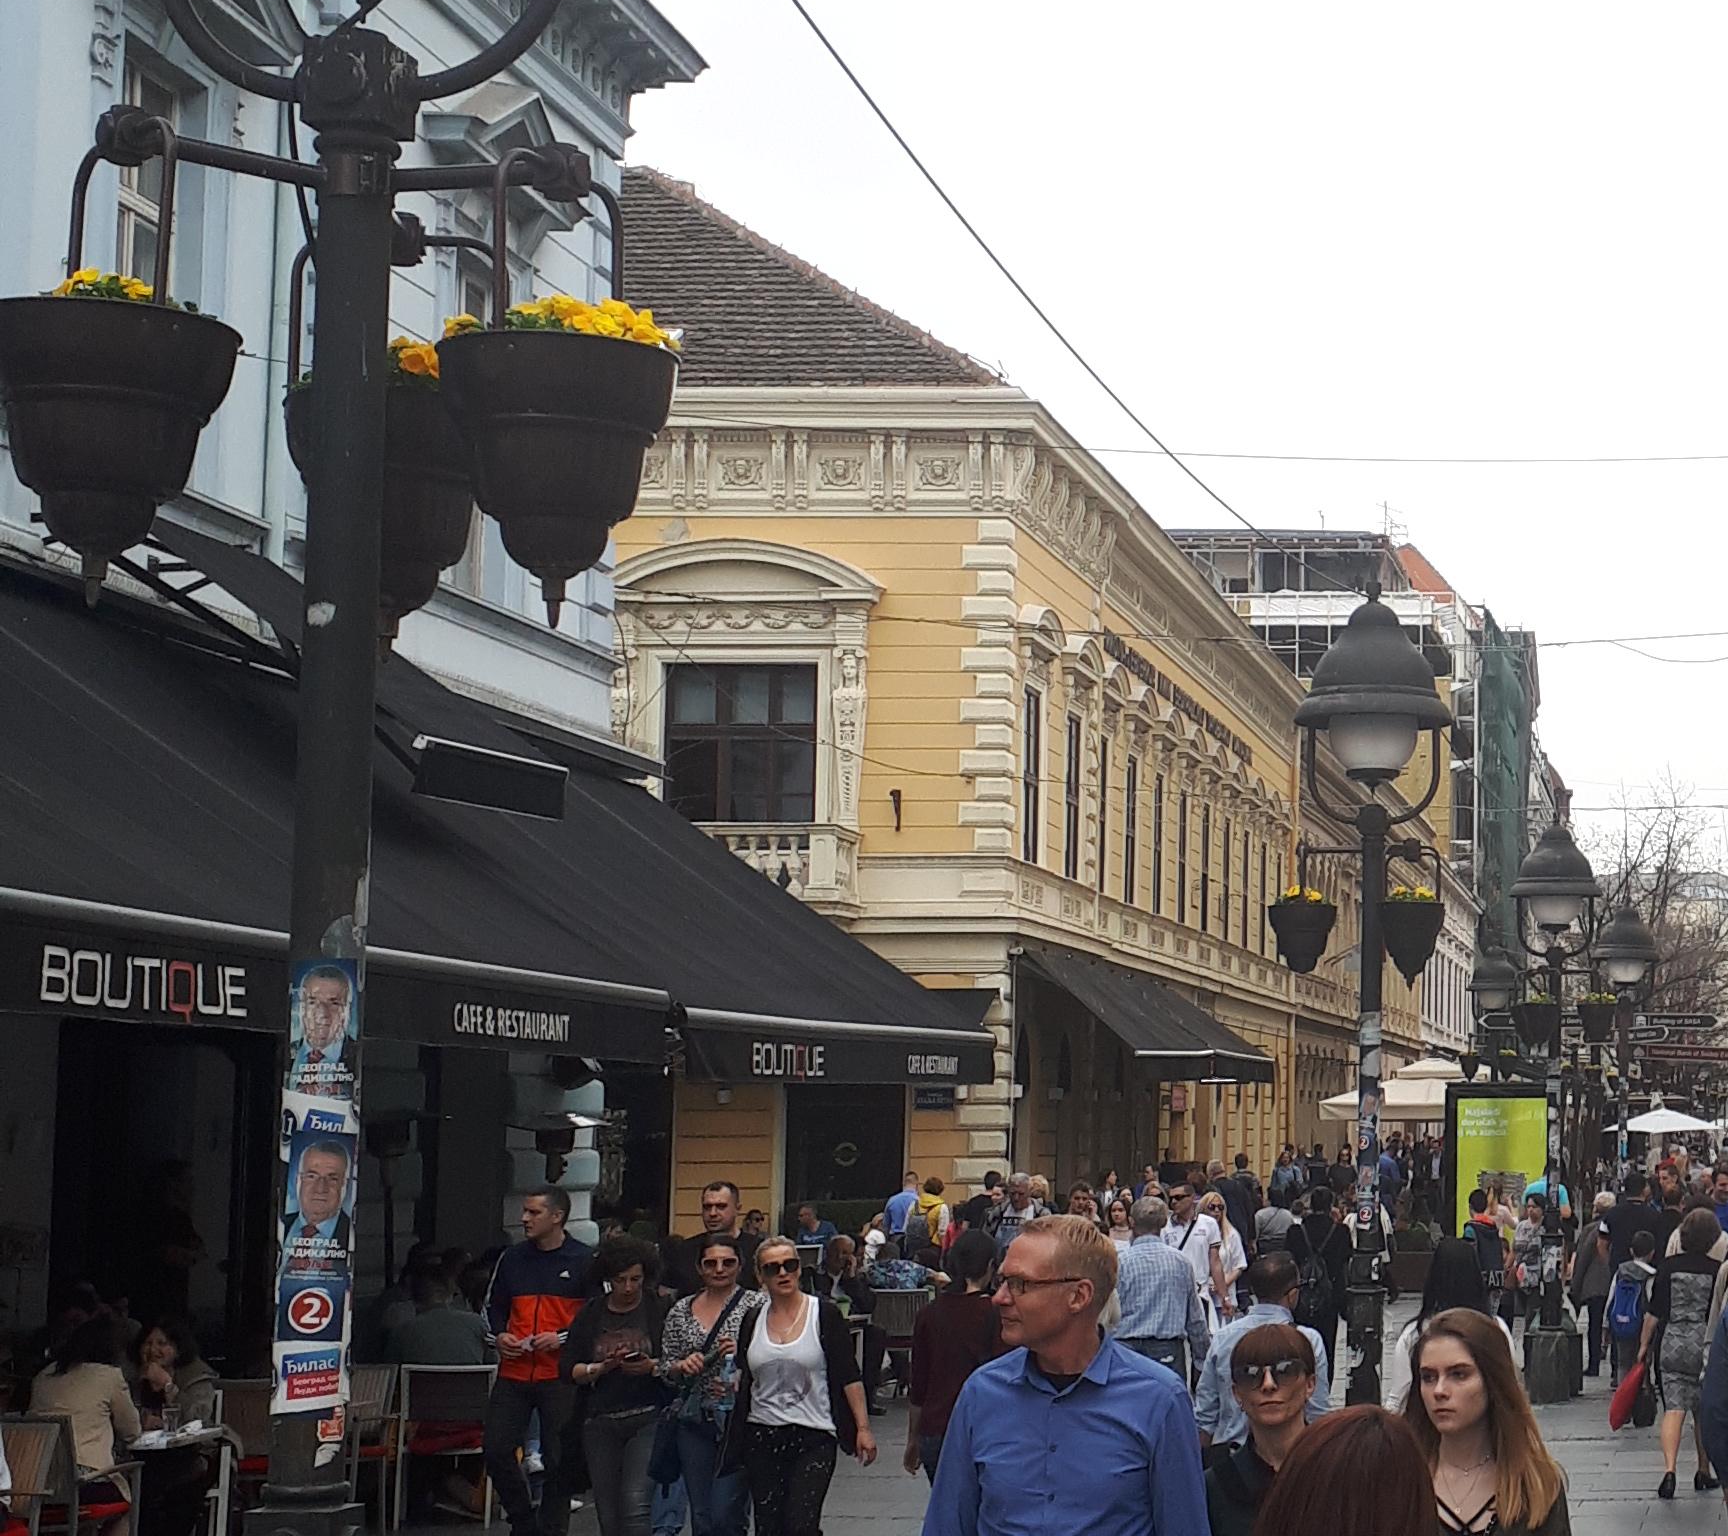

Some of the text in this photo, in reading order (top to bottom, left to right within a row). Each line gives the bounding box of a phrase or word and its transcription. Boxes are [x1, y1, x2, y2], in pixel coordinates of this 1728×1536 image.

[40, 944, 248, 1024] BOUTIQUE
[453, 1002, 570, 1043] CAFE & RESTAURANT
[752, 1042, 825, 1082] BOUTIQUE
[285, 1358, 335, 1374] Ђилас
